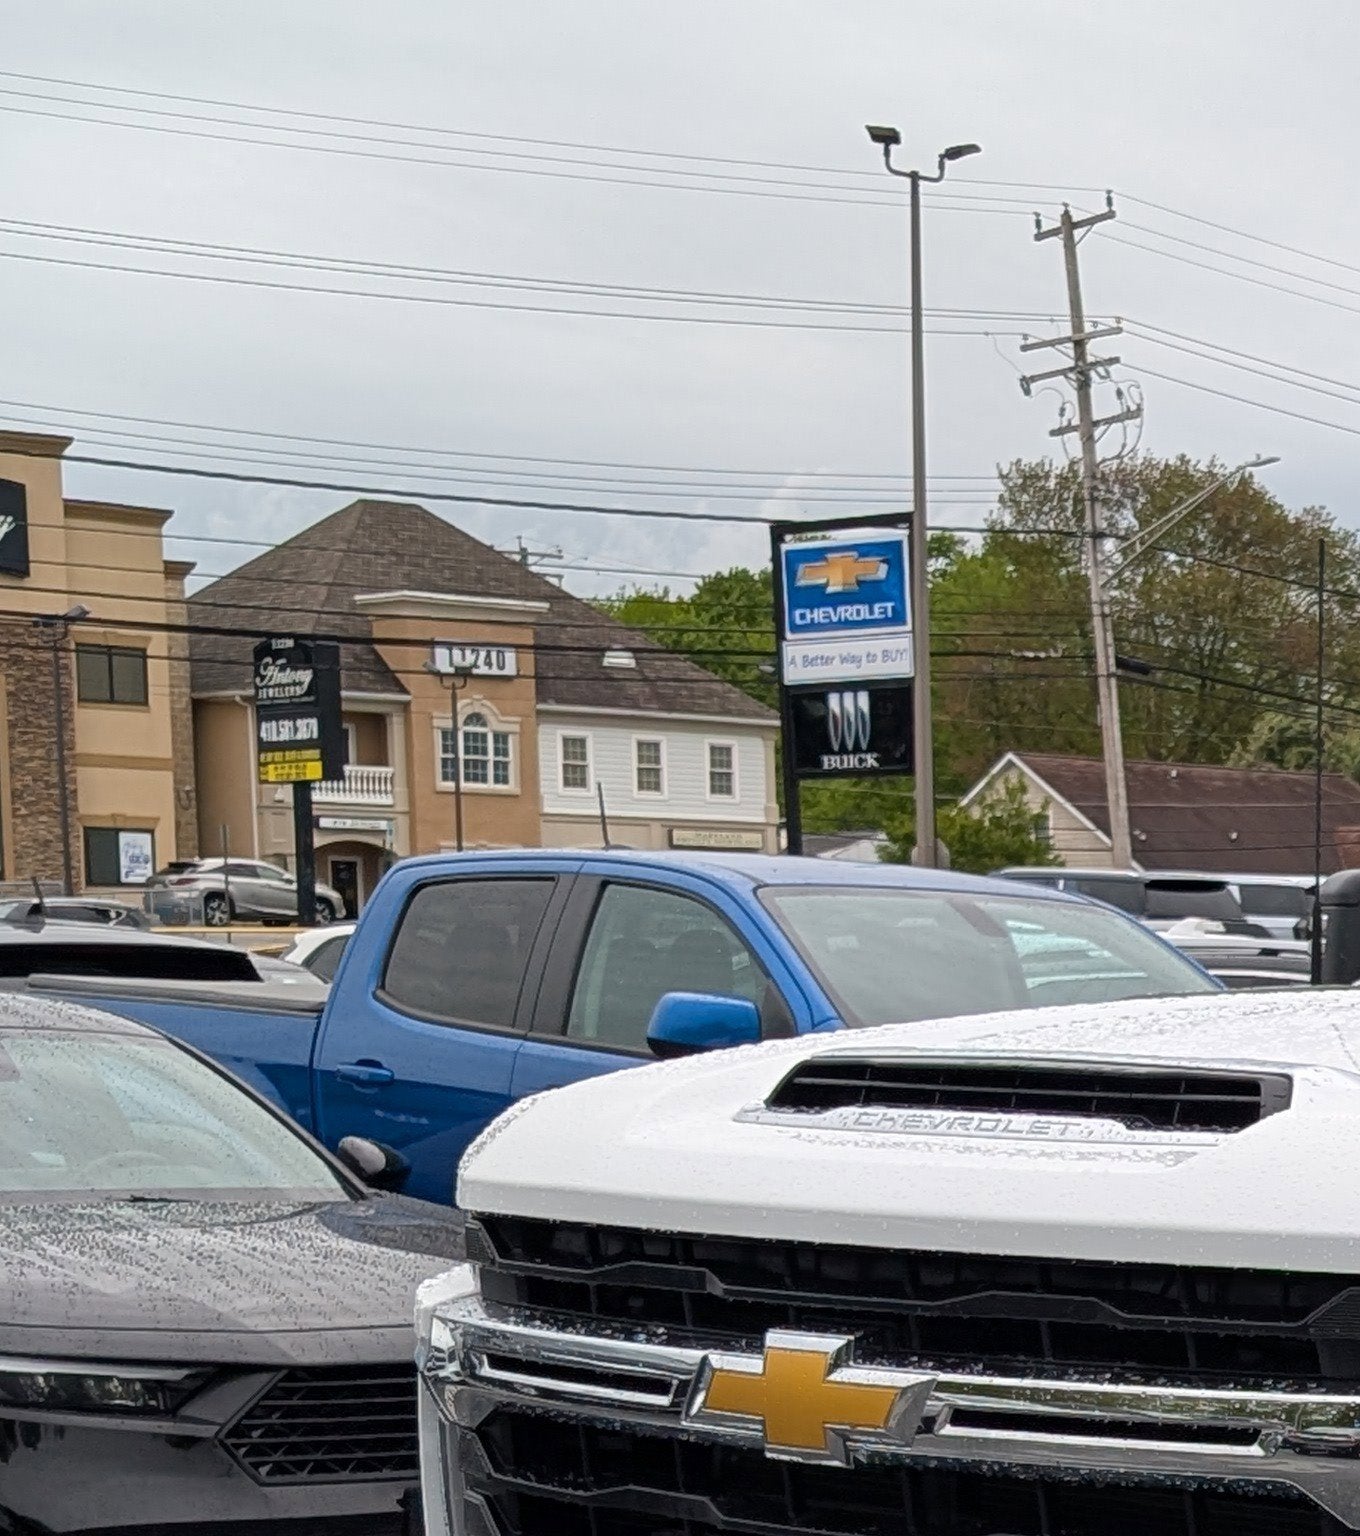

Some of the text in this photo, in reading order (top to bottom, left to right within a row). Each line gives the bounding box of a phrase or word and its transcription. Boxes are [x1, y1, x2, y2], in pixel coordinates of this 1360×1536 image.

[794, 602, 895, 625] CHEVROLET
[789, 655, 797, 667] A
[802, 654, 835, 668] Better
[839, 652, 862, 669] Way
[866, 651, 877, 663] to
[820, 752, 881, 769] BUICK
[853, 1111, 1082, 1137] CHEVROLET
